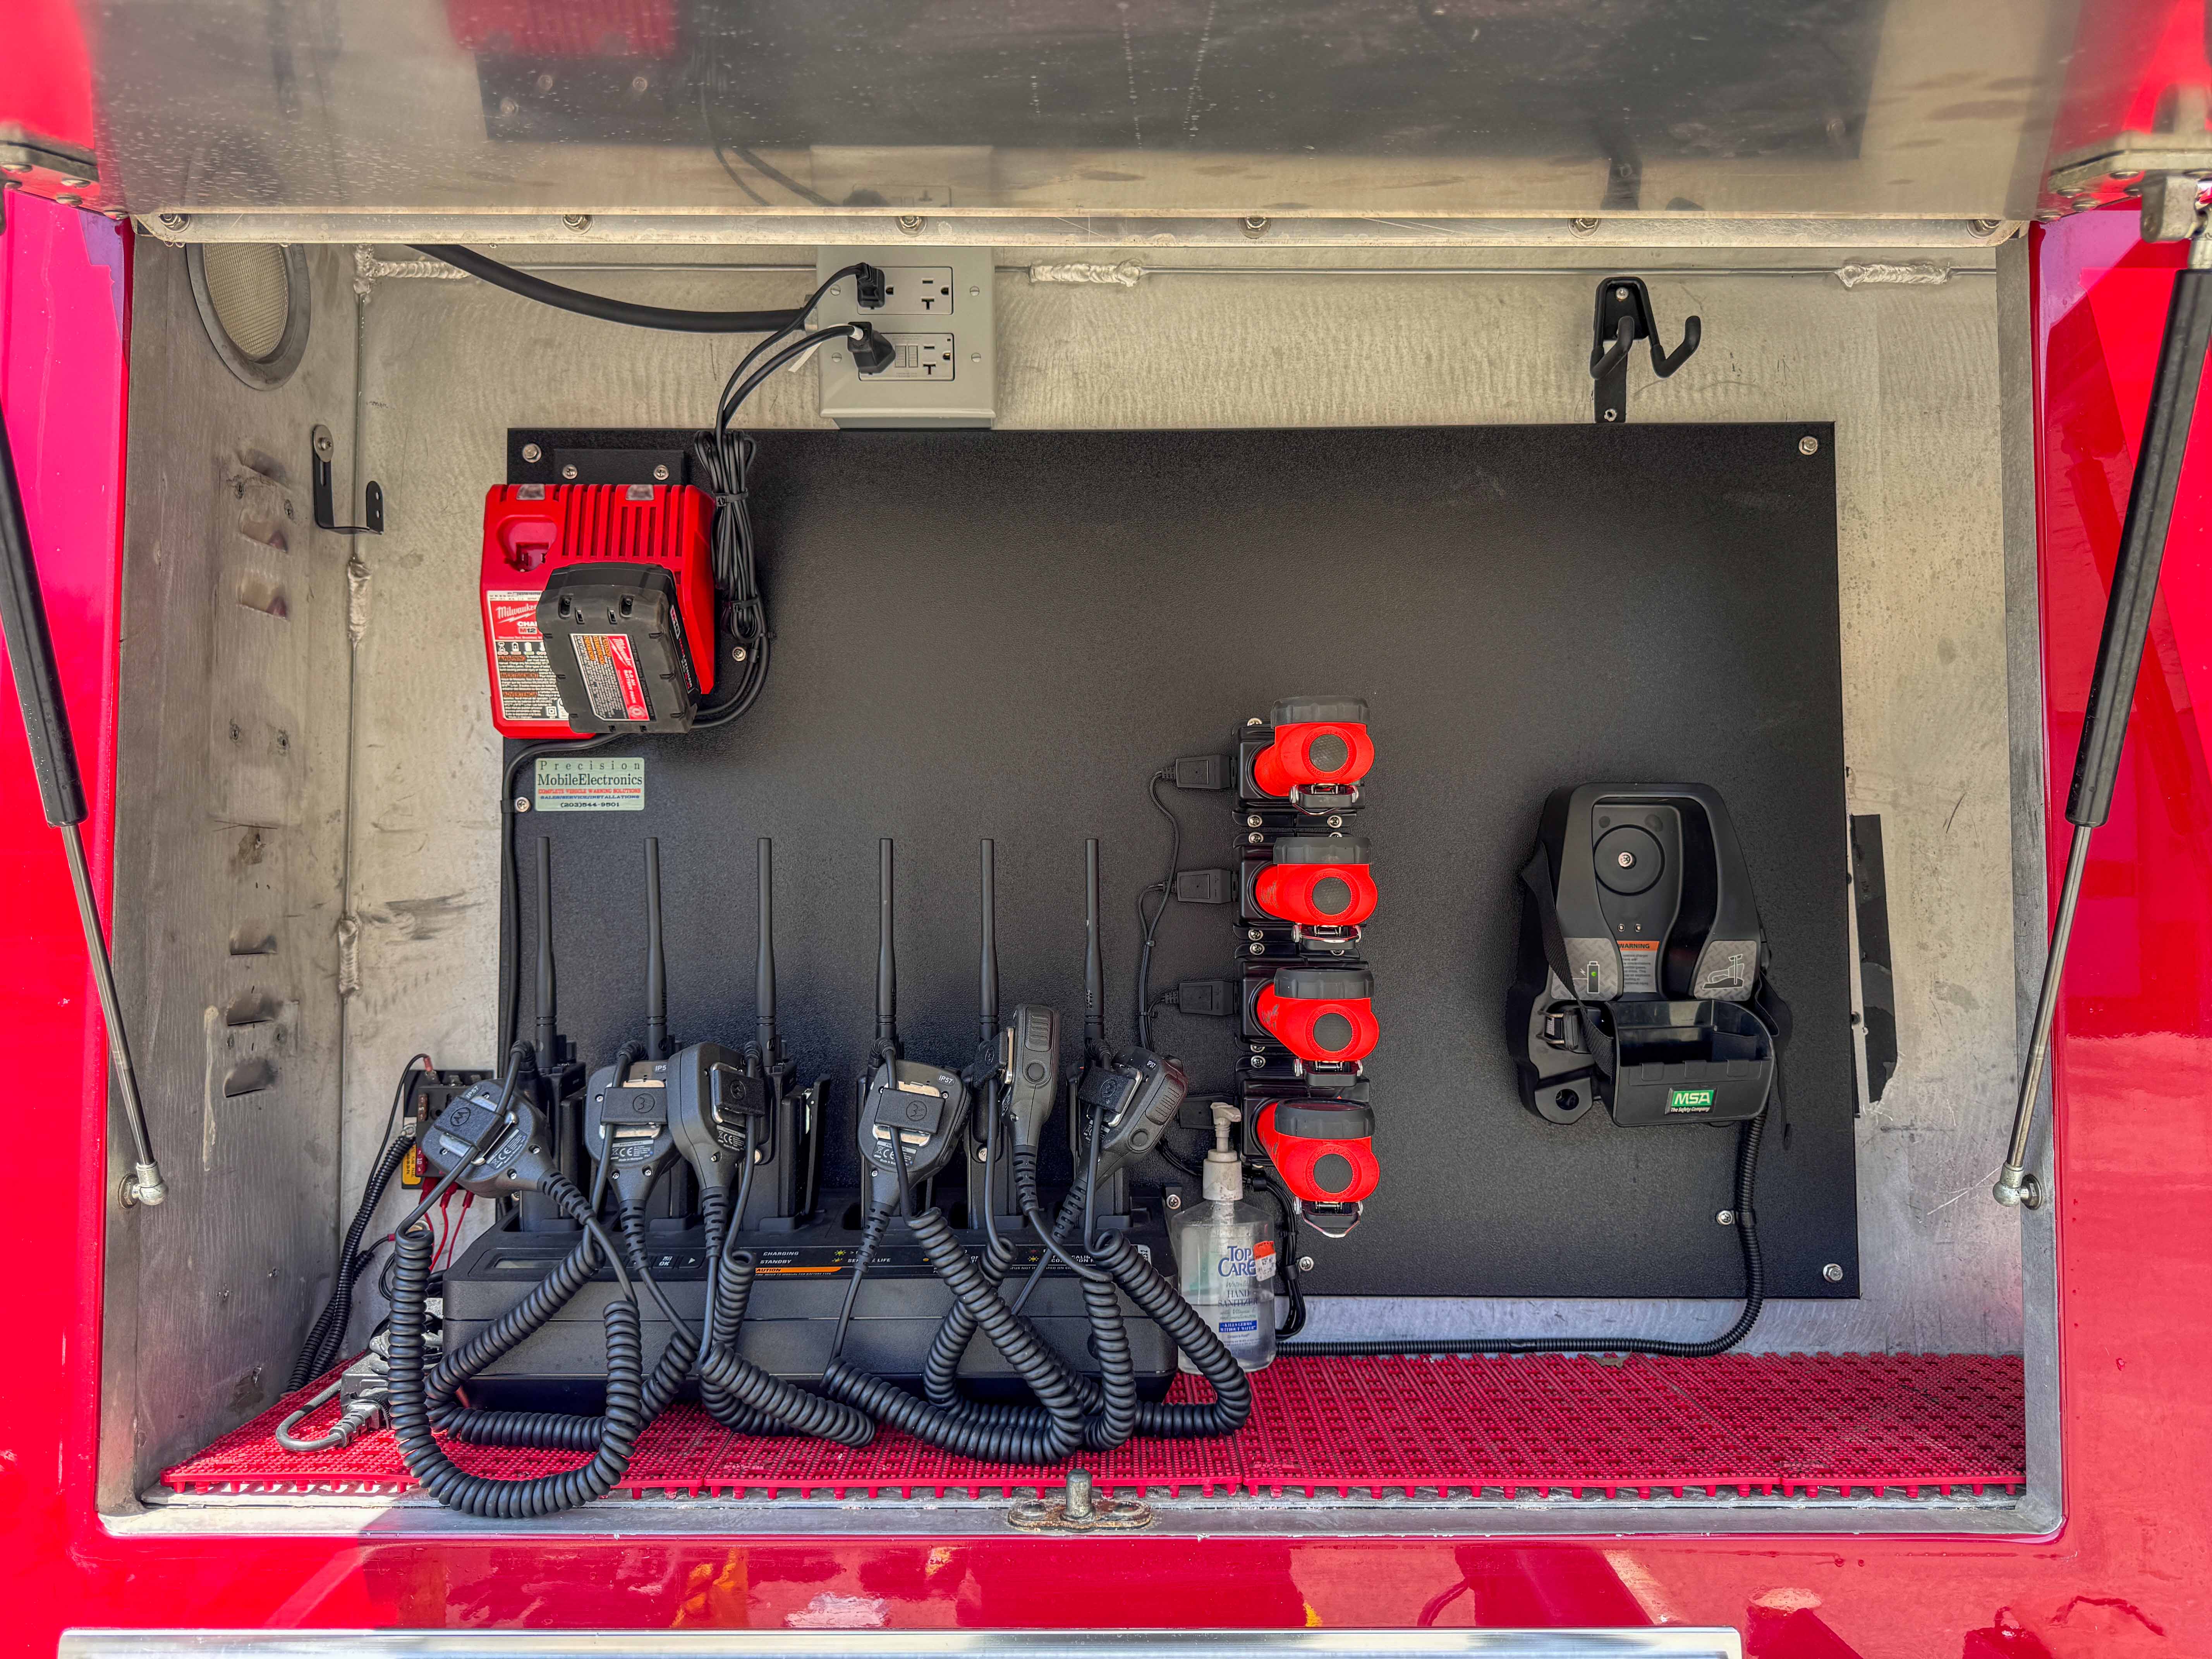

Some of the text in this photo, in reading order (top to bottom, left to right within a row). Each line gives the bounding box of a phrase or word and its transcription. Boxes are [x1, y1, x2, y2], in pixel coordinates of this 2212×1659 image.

[539, 760, 640, 770] Precision
[538, 774, 642, 785] MobileElectronics
[939, 1075, 953, 1084] IP57
[466, 1085, 479, 1098] IP57
[1674, 1092, 1711, 1104] MSA
[1227, 1289, 1250, 1298] HAND
[1218, 1298, 1258, 1307] SANITIZER
